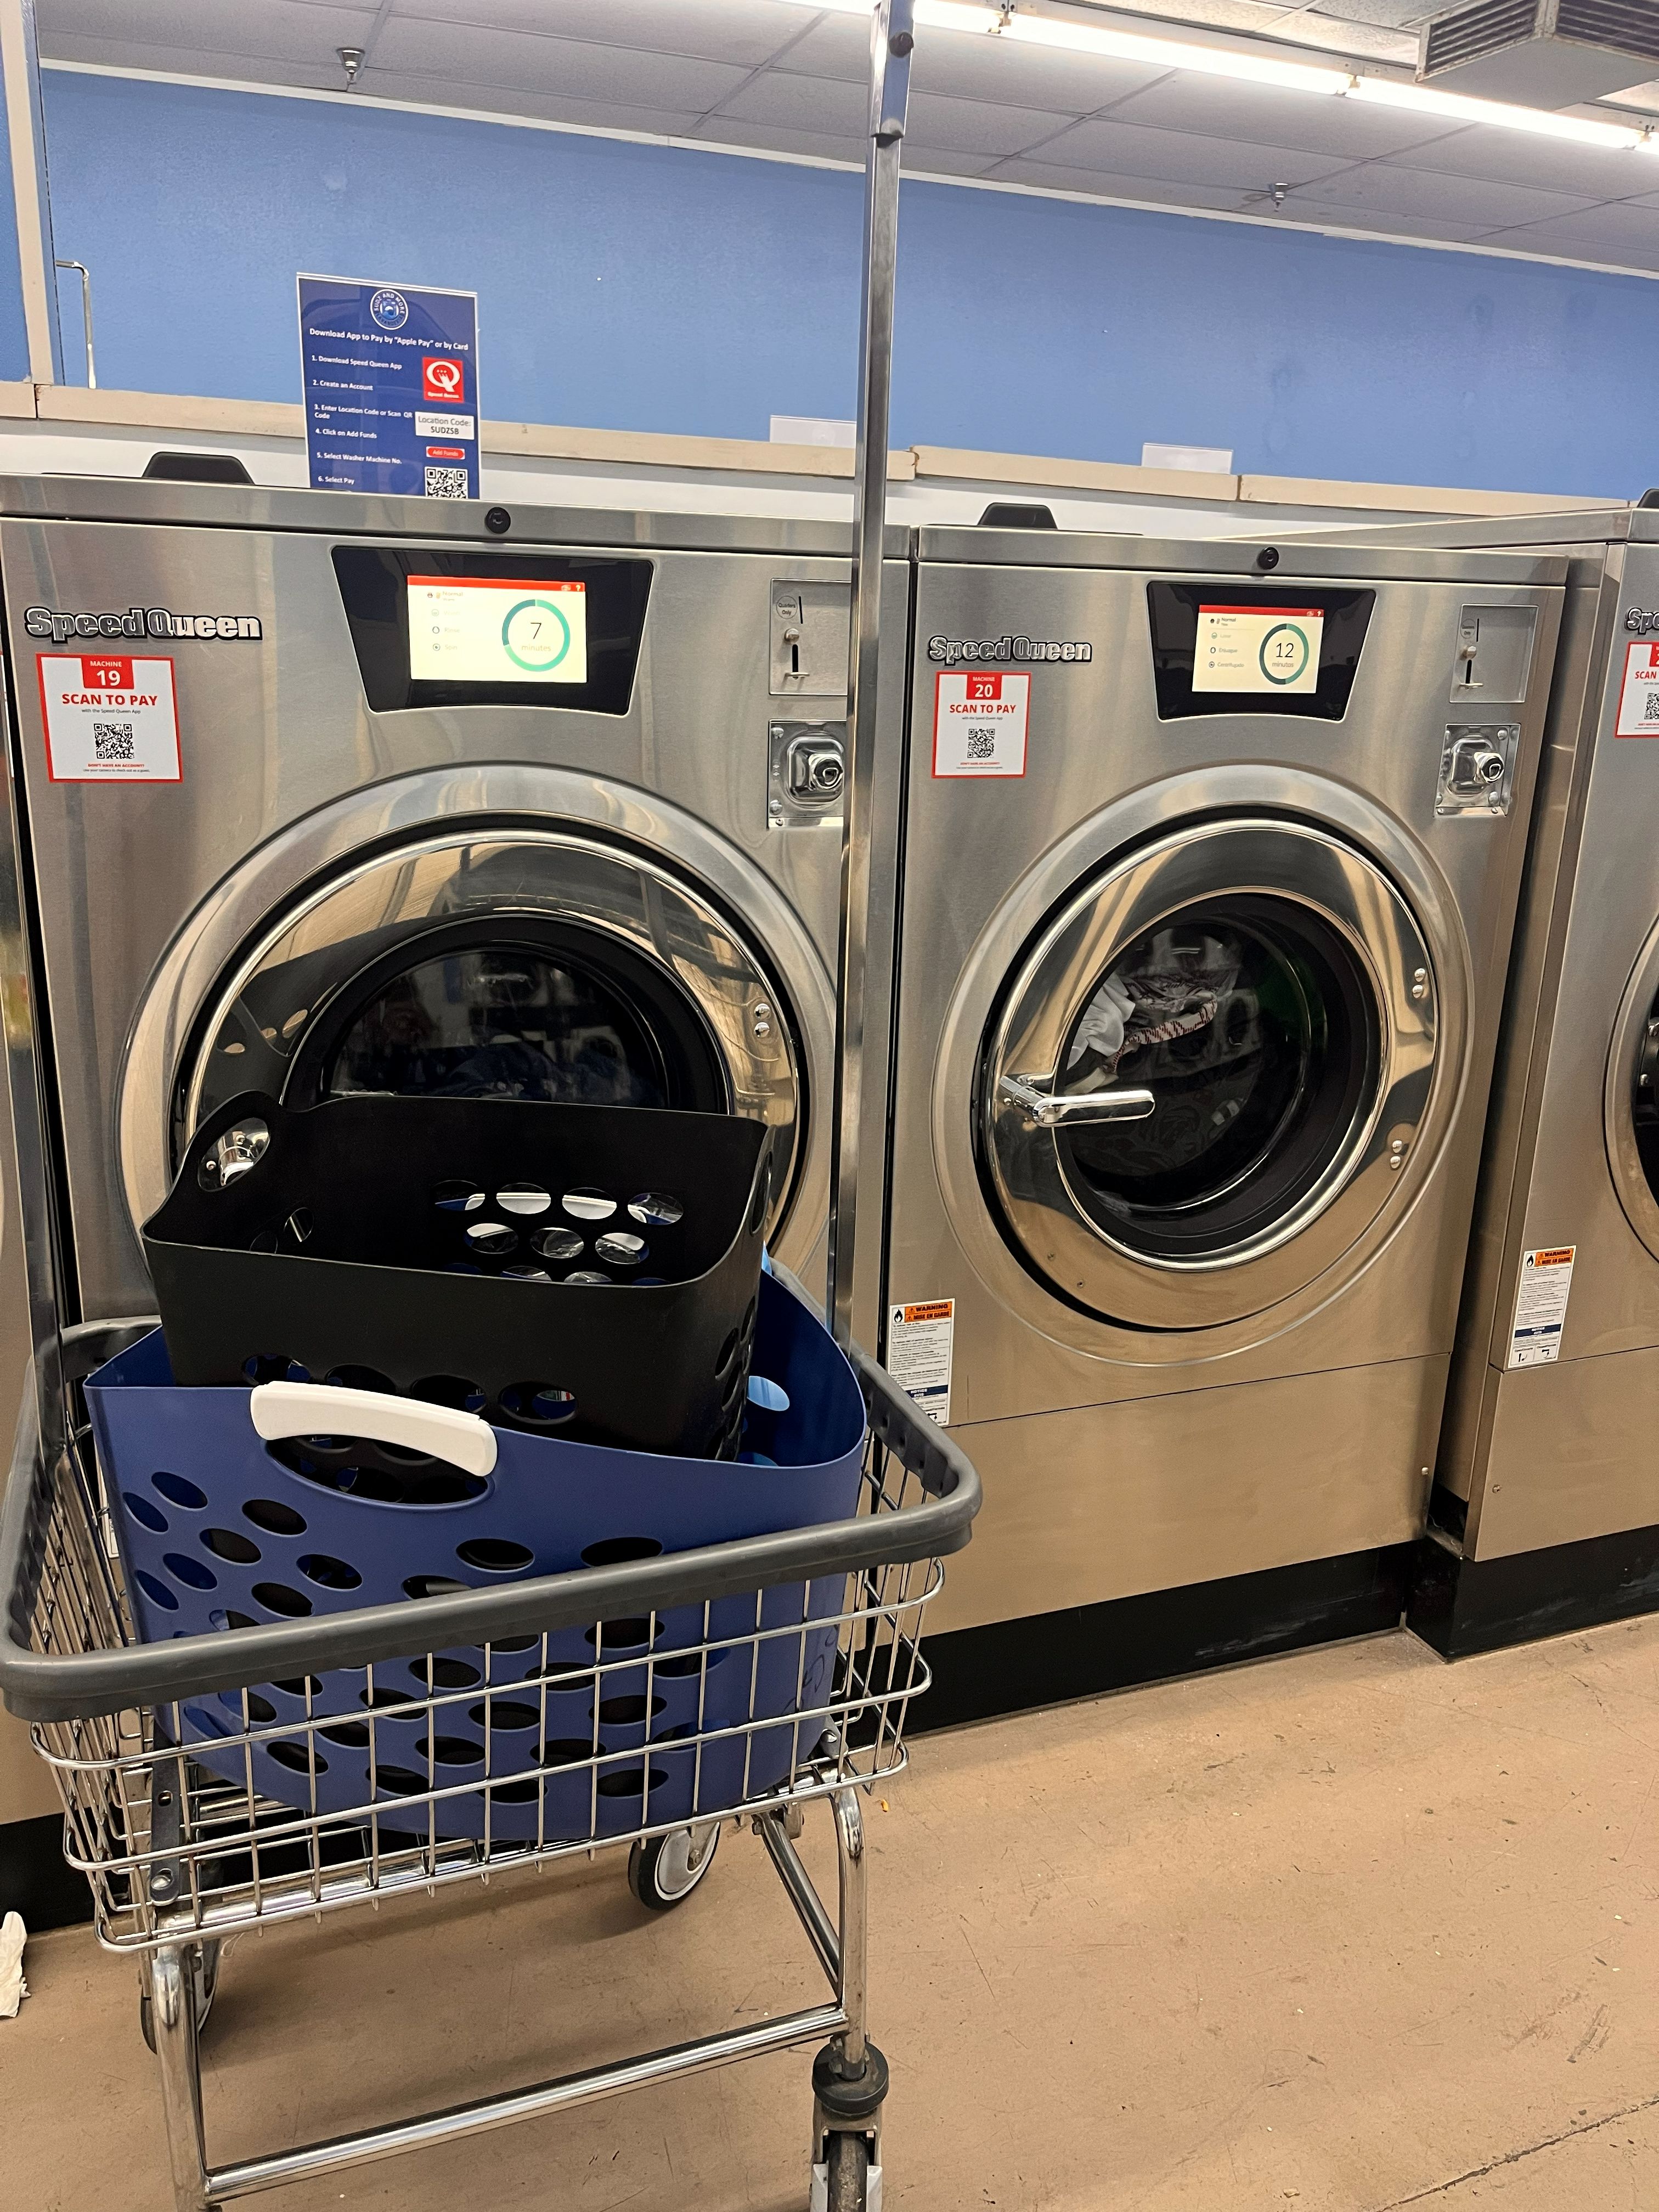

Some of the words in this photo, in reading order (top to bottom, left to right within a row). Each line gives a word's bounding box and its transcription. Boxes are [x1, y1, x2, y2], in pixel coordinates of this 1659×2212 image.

[309, 328, 345, 338] Download
[346, 332, 360, 341] App
[370, 334, 383, 343] Pay
[384, 336, 393, 344] by
[443, 341, 452, 350] by
[318, 356, 349, 364] Download
[418, 416, 448, 425] Location
[25, 607, 146, 643] Speed
[147, 607, 263, 640] Queen
[531, 622, 541, 639] 7
[929, 635, 1012, 665] Speed
[1013, 635, 1092, 662] Queen
[1276, 642, 1294, 657] 12
[97, 670, 121, 686] 19
[1635, 671, 1656, 679] SCAN
[975, 684, 993, 697] 20
[62, 693, 101, 705] SCAN
[105, 695, 125, 706] TO
[130, 695, 158, 706] PAY
[950, 704, 977, 713] SCAN
[980, 704, 994, 713] TO
[996, 704, 1016, 713] PAY
[916, 1304, 948, 1312] WARNING
